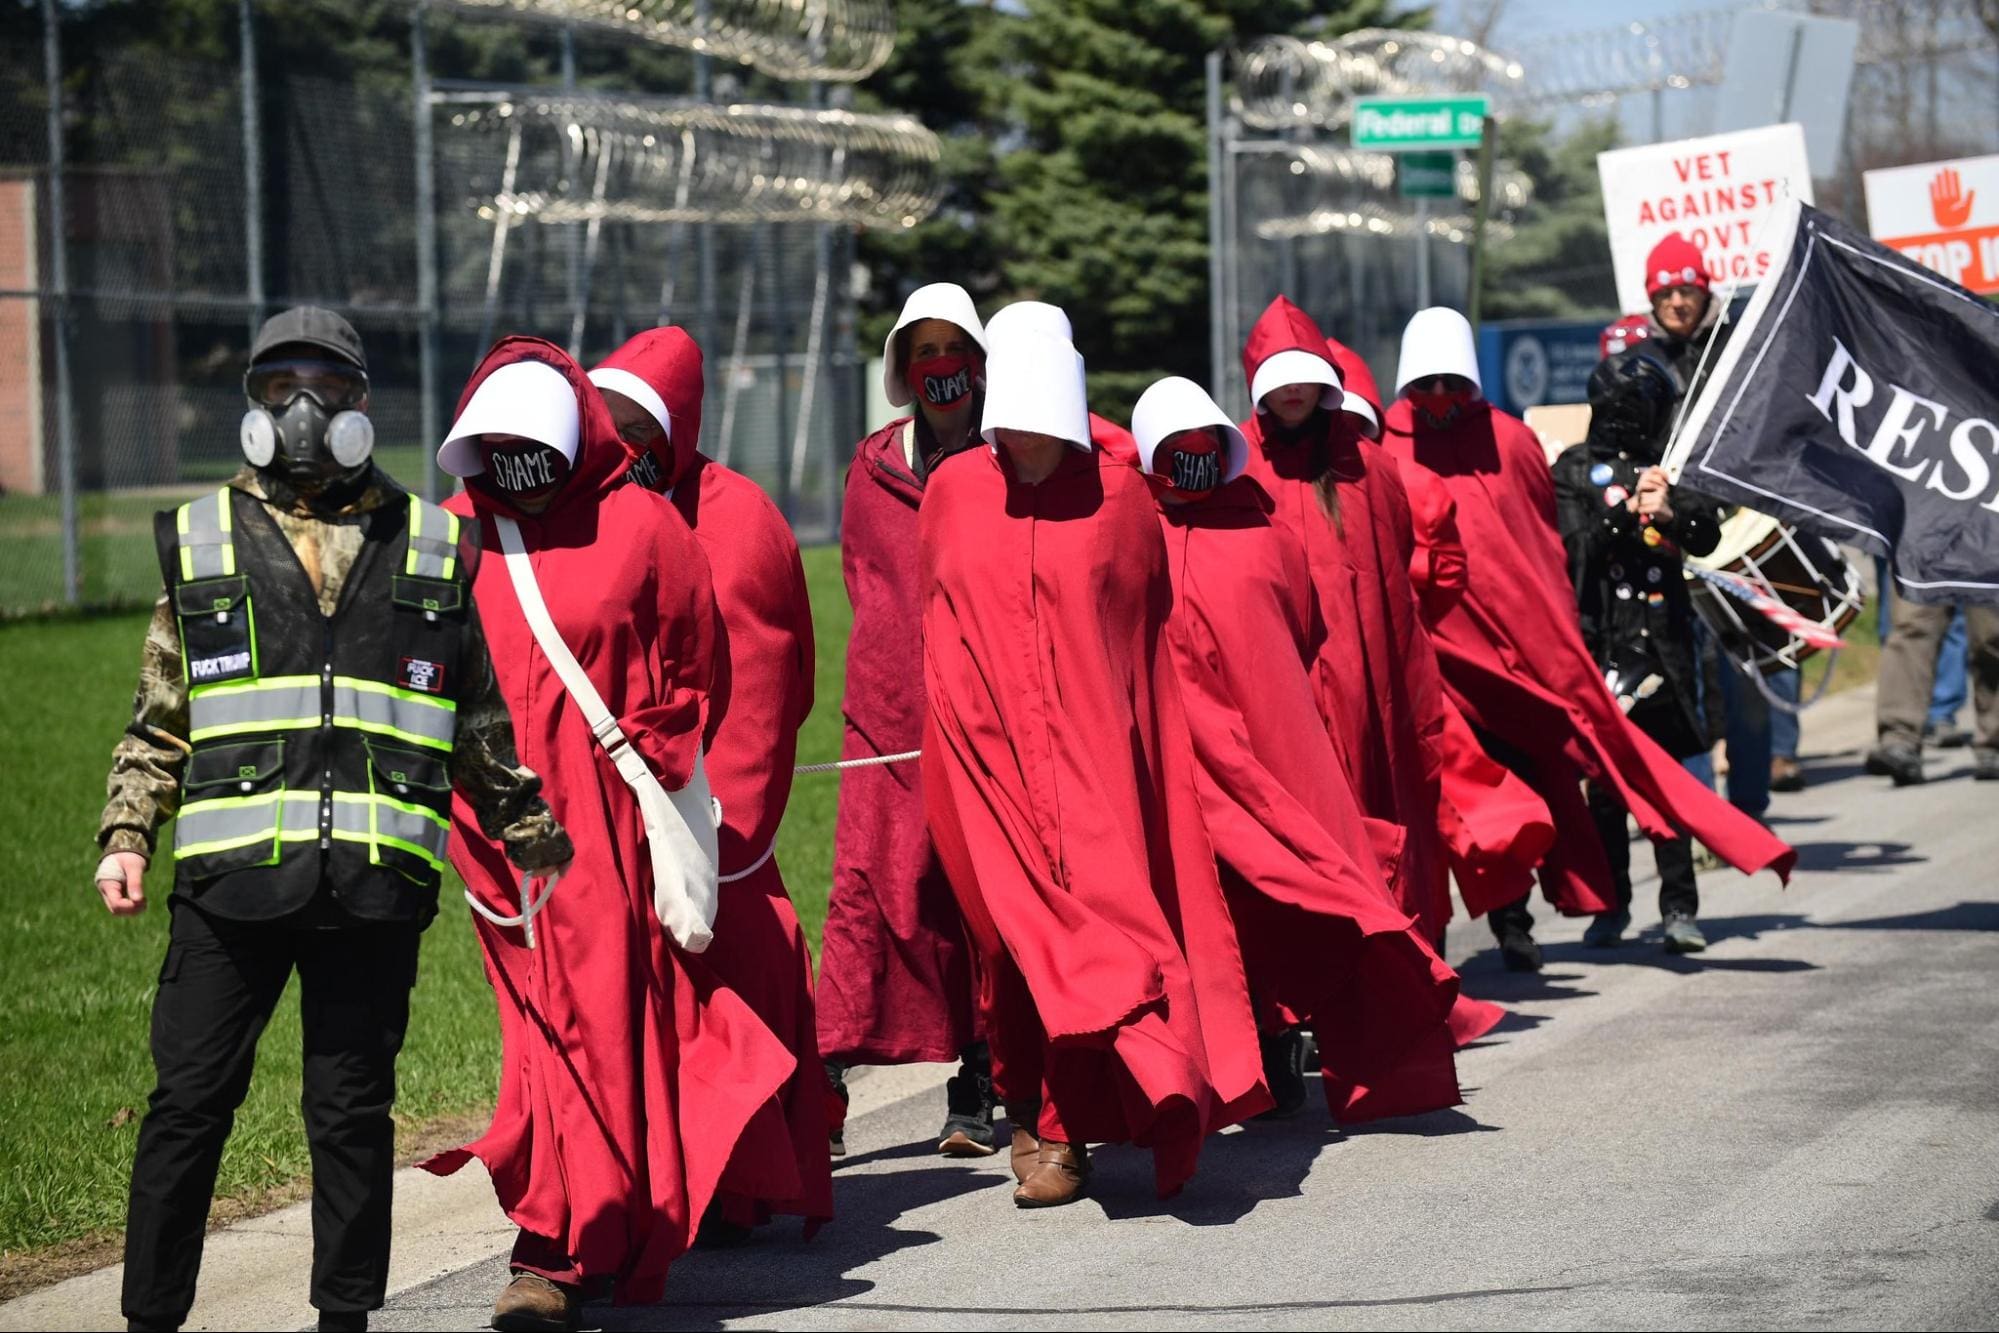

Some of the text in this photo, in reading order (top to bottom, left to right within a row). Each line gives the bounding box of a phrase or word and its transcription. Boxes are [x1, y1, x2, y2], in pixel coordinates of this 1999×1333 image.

[1358, 108, 1451, 137] Federal
[1672, 151, 1730, 183] VET
[1637, 178, 1776, 225] AGAINST
[1690, 220, 1751, 251] OVT
[1707, 251, 1770, 283] UGS
[1899, 240, 1973, 286] OP
[1805, 335, 1999, 513] RES
[492, 450, 556, 491] SHAME
[624, 450, 657, 487] AME
[191, 658, 220, 678] FUCK
[407, 662, 434, 677] FUCK
[411, 674, 428, 686] ICE
